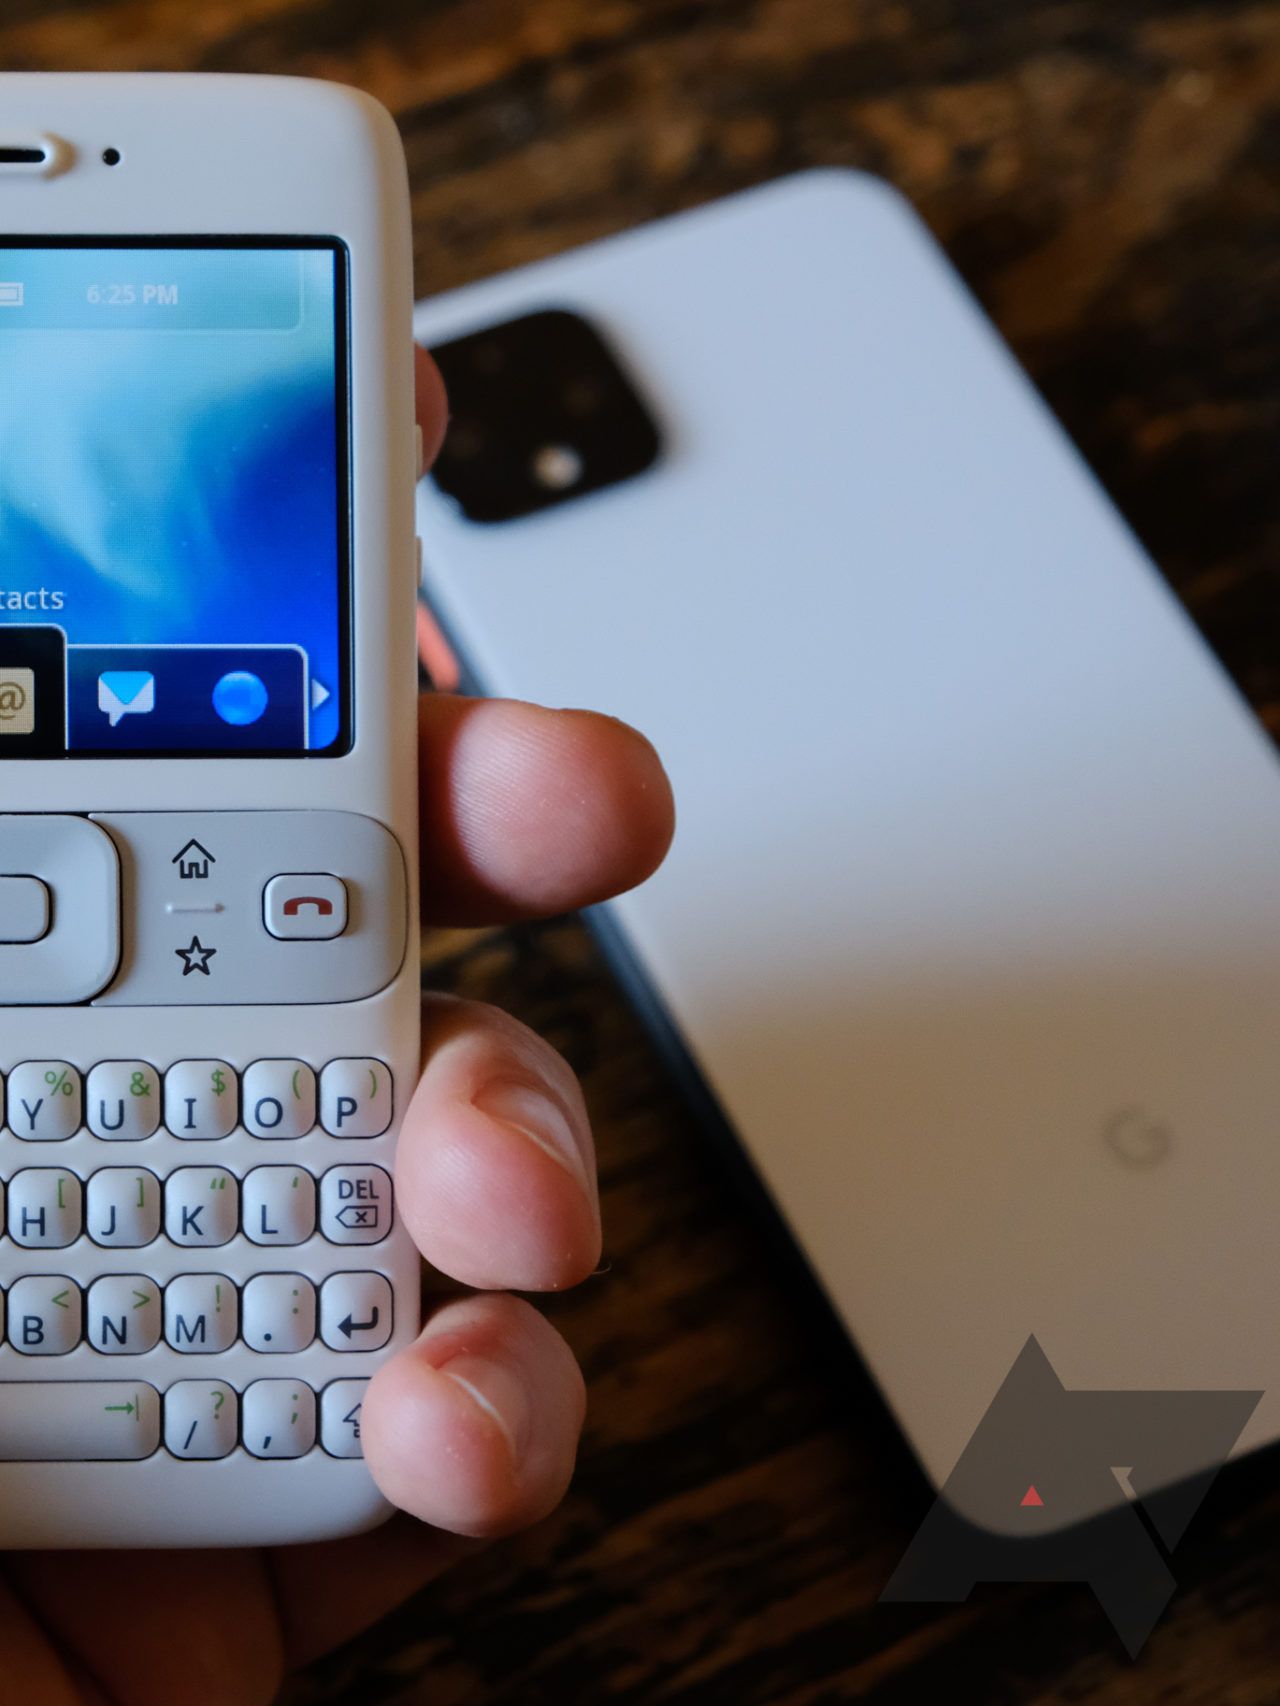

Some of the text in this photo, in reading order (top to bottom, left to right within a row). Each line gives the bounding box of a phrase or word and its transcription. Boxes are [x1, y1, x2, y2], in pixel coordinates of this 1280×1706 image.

[87, 284, 178, 305] 6:25 PM
[44, 1070, 73, 1096] %
[129, 1071, 150, 1096] &
[211, 1068, 226, 1096] $
[21, 1098, 43, 1130] Y
[100, 1098, 125, 1130] U
[184, 1098, 197, 1129] I
[254, 1097, 283, 1128] O
[336, 1096, 357, 1127] P
[338, 1179, 379, 1200] DEL
[21, 1206, 45, 1236] H
[101, 1205, 115, 1236] J
[181, 1205, 204, 1236] K
[261, 1204, 278, 1234] L
[22, 1315, 44, 1345] B
[102, 1315, 127, 1345] N
[175, 1314, 206, 1343] M
